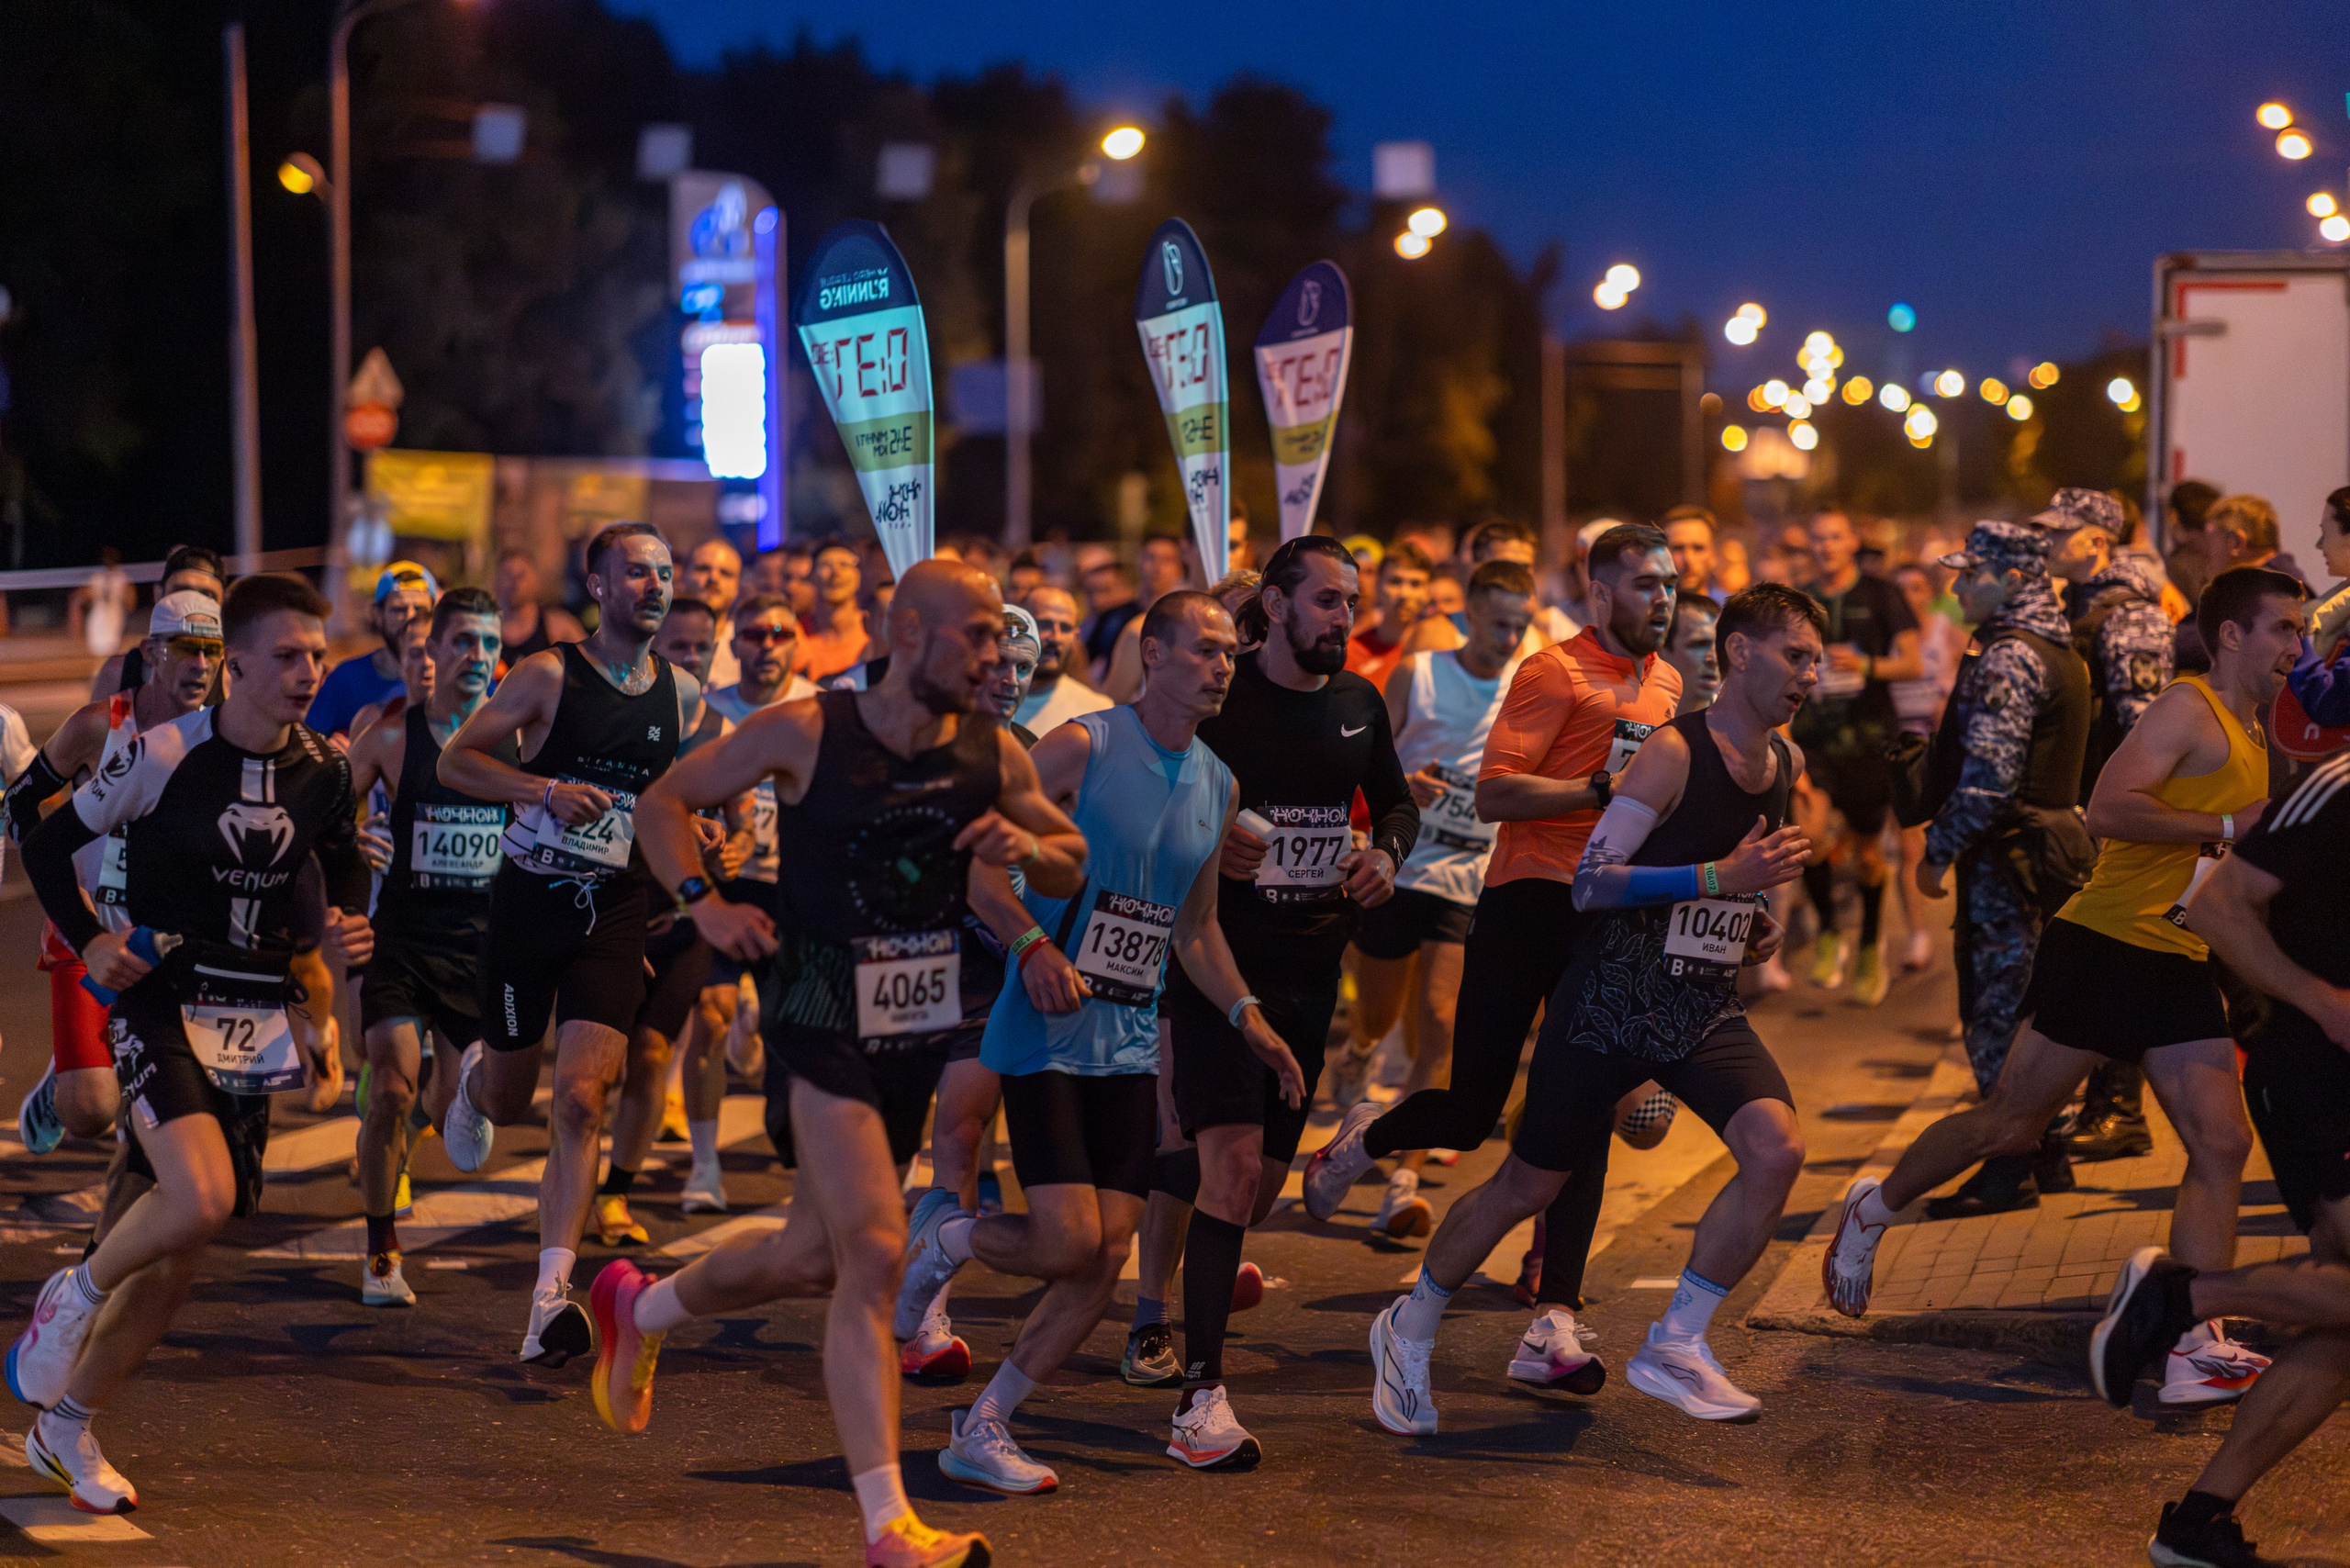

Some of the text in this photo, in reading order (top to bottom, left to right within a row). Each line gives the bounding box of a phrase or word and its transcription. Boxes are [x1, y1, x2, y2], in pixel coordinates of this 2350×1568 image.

[419, 831, 499, 858] 14090
[561, 835, 610, 856] ВЛАДИМИР
[1272, 836, 1344, 867] 1977
[212, 865, 289, 892] VENUM
[1288, 868, 1324, 879] СЕРГЕЙ
[1678, 905, 1751, 943] 10402
[1012, 935, 1030, 953] 1387
[1091, 923, 1167, 968] 13878
[1702, 942, 1727, 955] ИВАН
[1106, 961, 1144, 978] МАКСИМ
[873, 967, 946, 1011] 4065
[504, 982, 519, 1036] ADIXION
[217, 1017, 255, 1052] 72
[218, 1053, 264, 1065] ДМИТРИЙ
